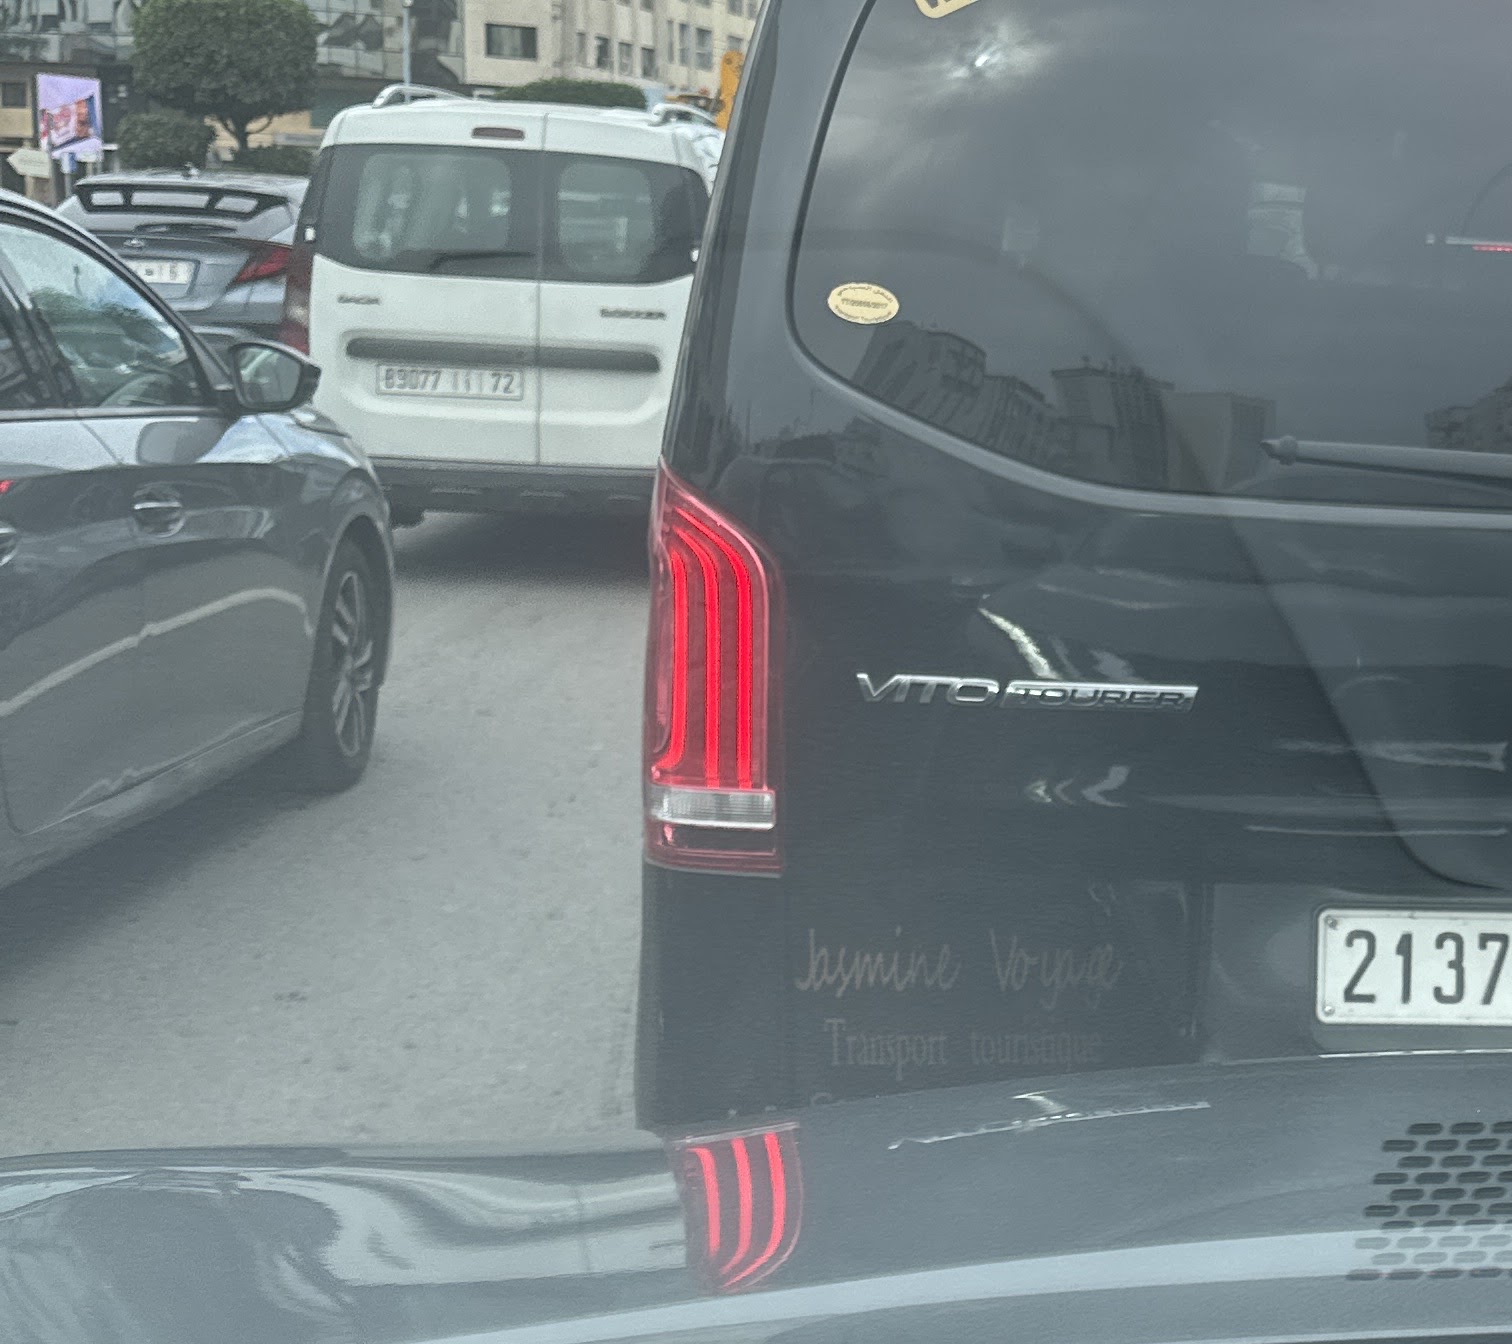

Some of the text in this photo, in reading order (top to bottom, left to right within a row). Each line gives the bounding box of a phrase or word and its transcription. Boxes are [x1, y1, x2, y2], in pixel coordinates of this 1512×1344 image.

[492, 371, 515, 394] 72
[857, 673, 1195, 708] VITO TOURER
[823, 1018, 949, 1081] Transport
